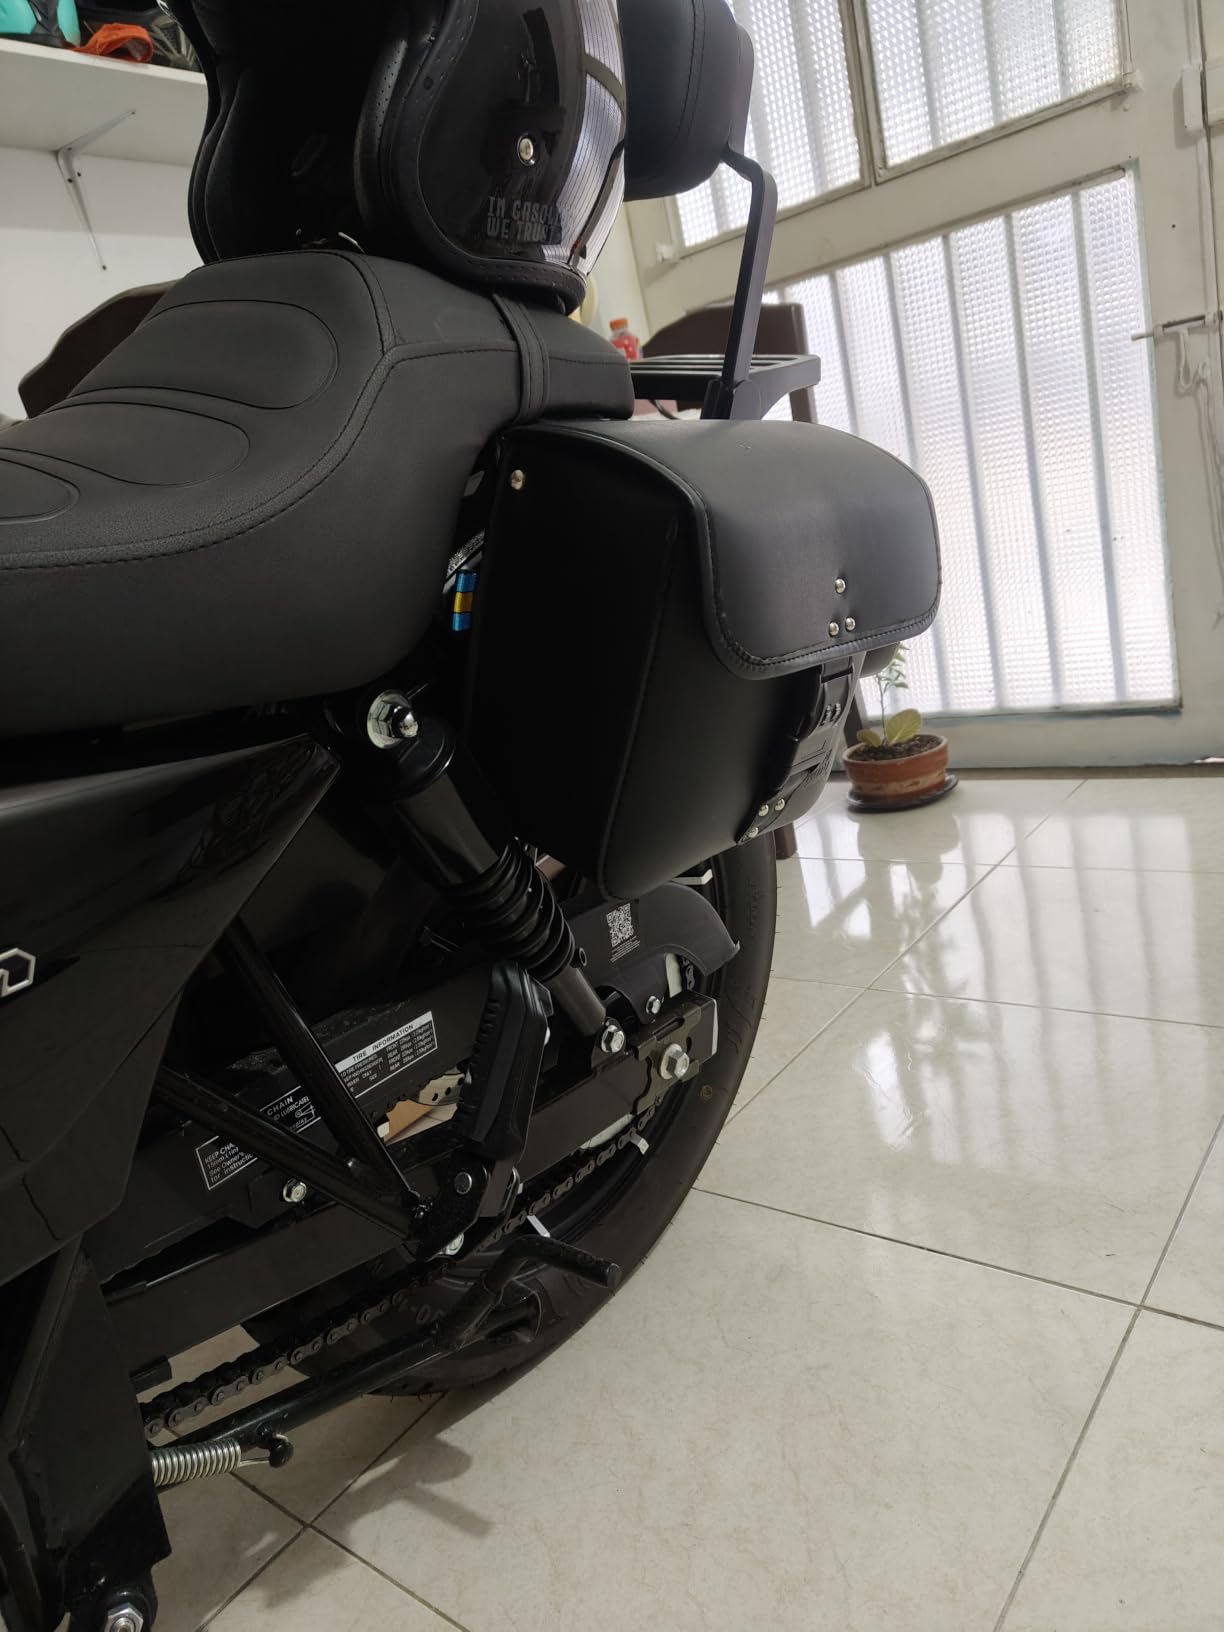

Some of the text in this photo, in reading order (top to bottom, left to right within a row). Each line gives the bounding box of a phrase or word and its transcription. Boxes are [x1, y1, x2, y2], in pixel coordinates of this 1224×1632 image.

[487, 217, 560, 244] WE TRUST
[352, 1051, 367, 1062] TIRE
[372, 1024, 414, 1051] INFORMATION
[266, 1096, 293, 1116] CHAIN
[204, 1141, 235, 1163] KEEP CHA
[209, 1166, 221, 1177] See
[210, 1173, 221, 1183] for
